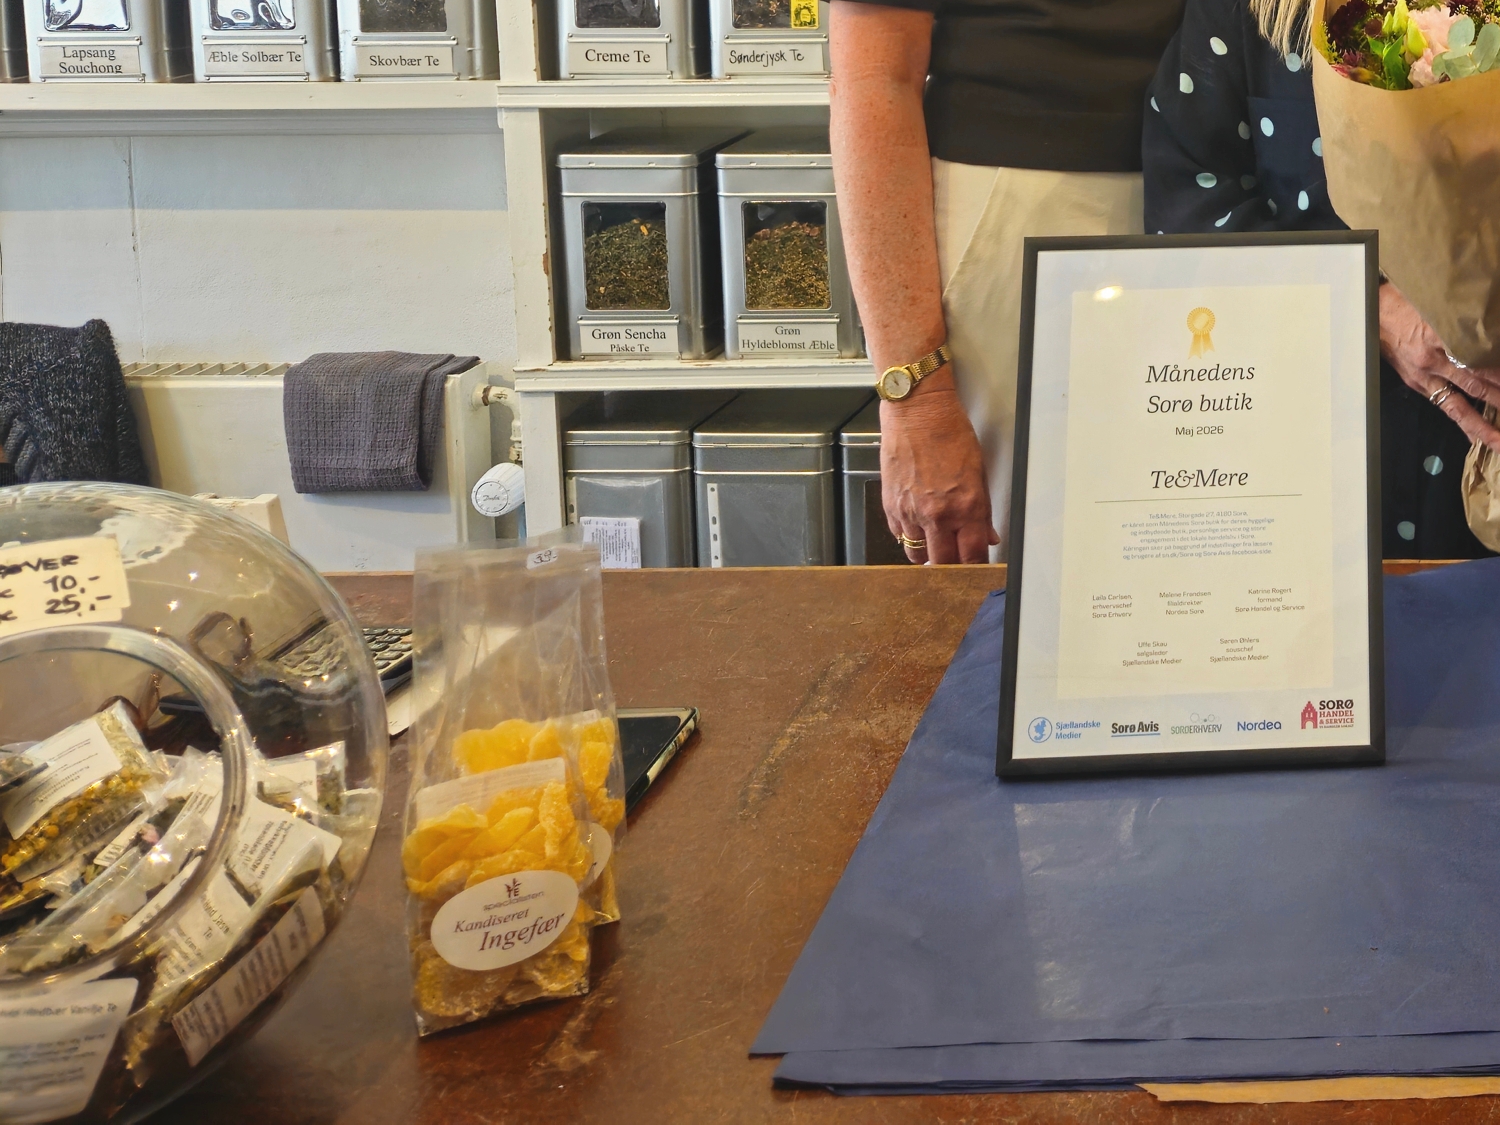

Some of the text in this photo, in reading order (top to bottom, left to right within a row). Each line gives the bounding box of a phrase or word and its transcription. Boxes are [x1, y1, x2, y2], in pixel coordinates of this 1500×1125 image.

[62, 47, 116, 61] Lapsang
[208, 51, 302, 63] Æble Solbær Te
[585, 49, 651, 63] Creme Te
[729, 48, 804, 67] Sønderjysk Te
[369, 55, 440, 67] Skovbær Te
[59, 62, 122, 75] Souchong
[592, 328, 667, 340] Grøn Sencha
[775, 325, 801, 336] Grøn
[610, 343, 650, 353] Påske Te
[742, 339, 835, 351] Hyldeblomst Æble
[1145, 364, 1255, 383] Månedens
[1147, 393, 1253, 414] Sorø butik
[1175, 425, 1224, 437] Maj 2026
[1150, 468, 1249, 489] Te&Mere
[1319, 699, 1354, 711] SORØ
[1319, 710, 1354, 718] HANDEL
[1055, 720, 1101, 731] Sjællandske
[1111, 721, 1159, 734] Sorø Avis
[1237, 720, 1282, 732] Nordea
[1055, 732, 1082, 740] Medier
[454, 908, 530, 934] Kandiseret
[478, 912, 566, 952] Ingefær
